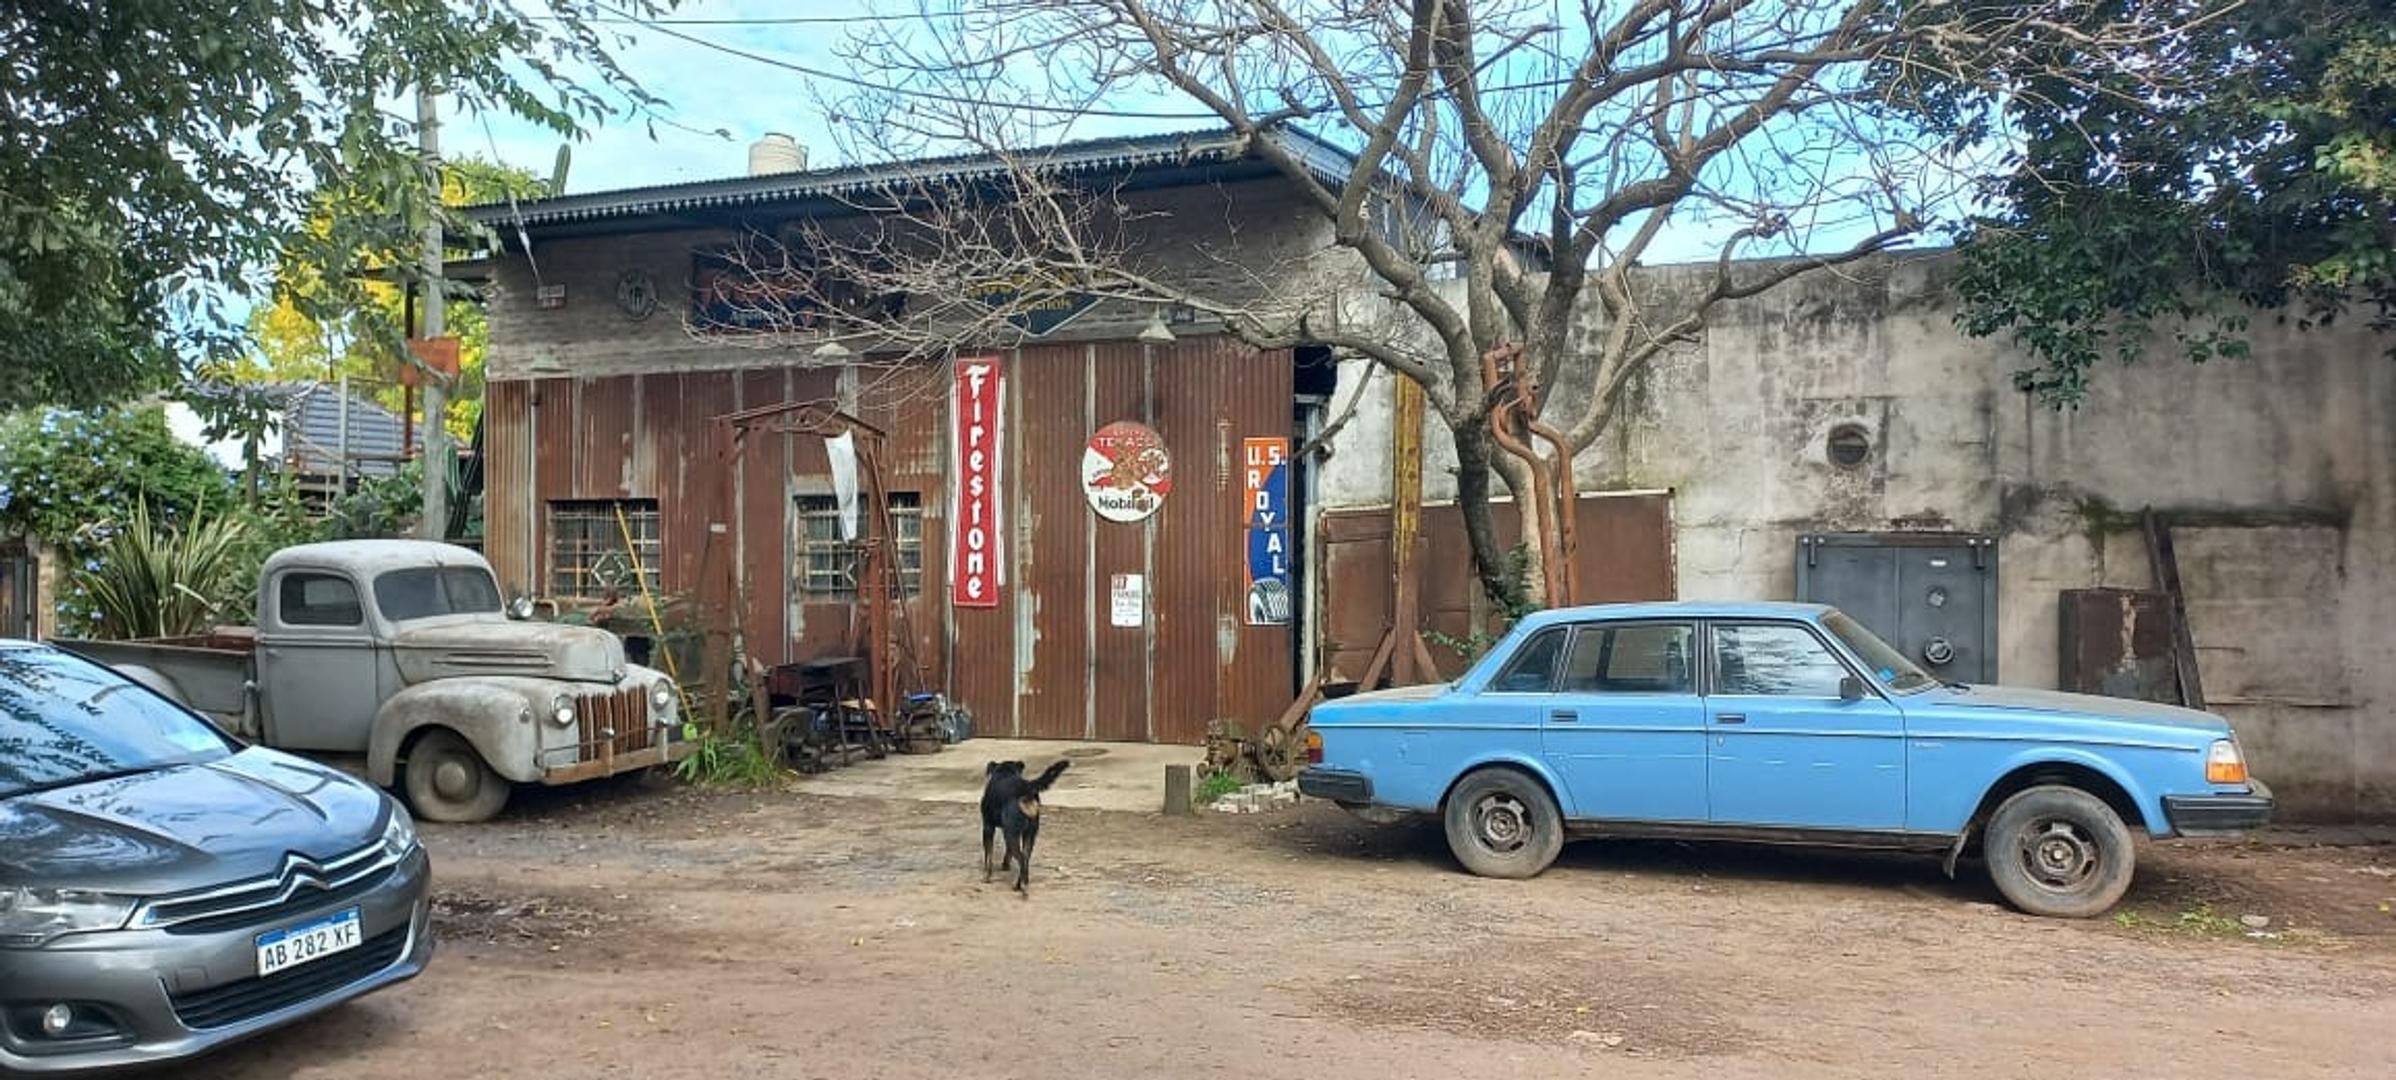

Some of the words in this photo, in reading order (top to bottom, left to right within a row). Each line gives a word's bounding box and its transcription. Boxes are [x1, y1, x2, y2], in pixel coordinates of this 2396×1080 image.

[966, 365, 991, 598] Firestone
[1247, 446, 1286, 465] U.S.
[1248, 470, 1284, 574] ROYAL
[265, 944, 287, 969] AB
[292, 932, 328, 959] 282
[333, 922, 356, 946] XF
